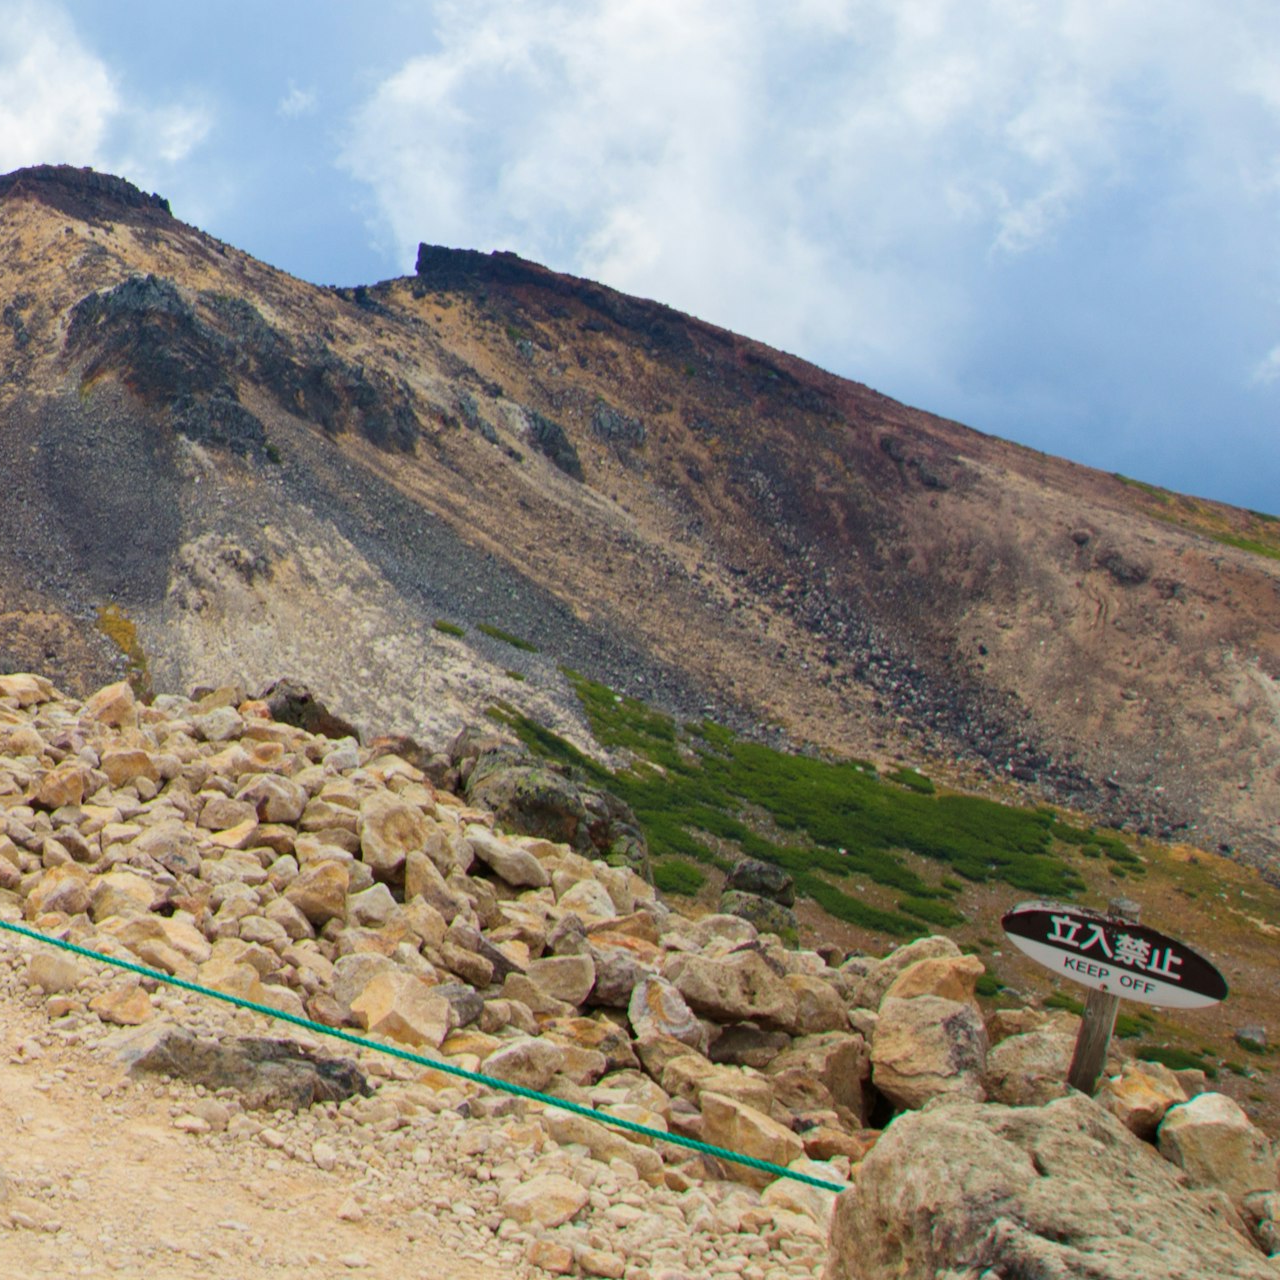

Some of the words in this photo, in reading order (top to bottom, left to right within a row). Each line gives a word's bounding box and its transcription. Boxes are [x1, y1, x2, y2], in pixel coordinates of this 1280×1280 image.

[1047, 914, 1183, 981] 立入禁止
[1064, 957, 1109, 978] KEEP
[1121, 976, 1155, 994] OFF
